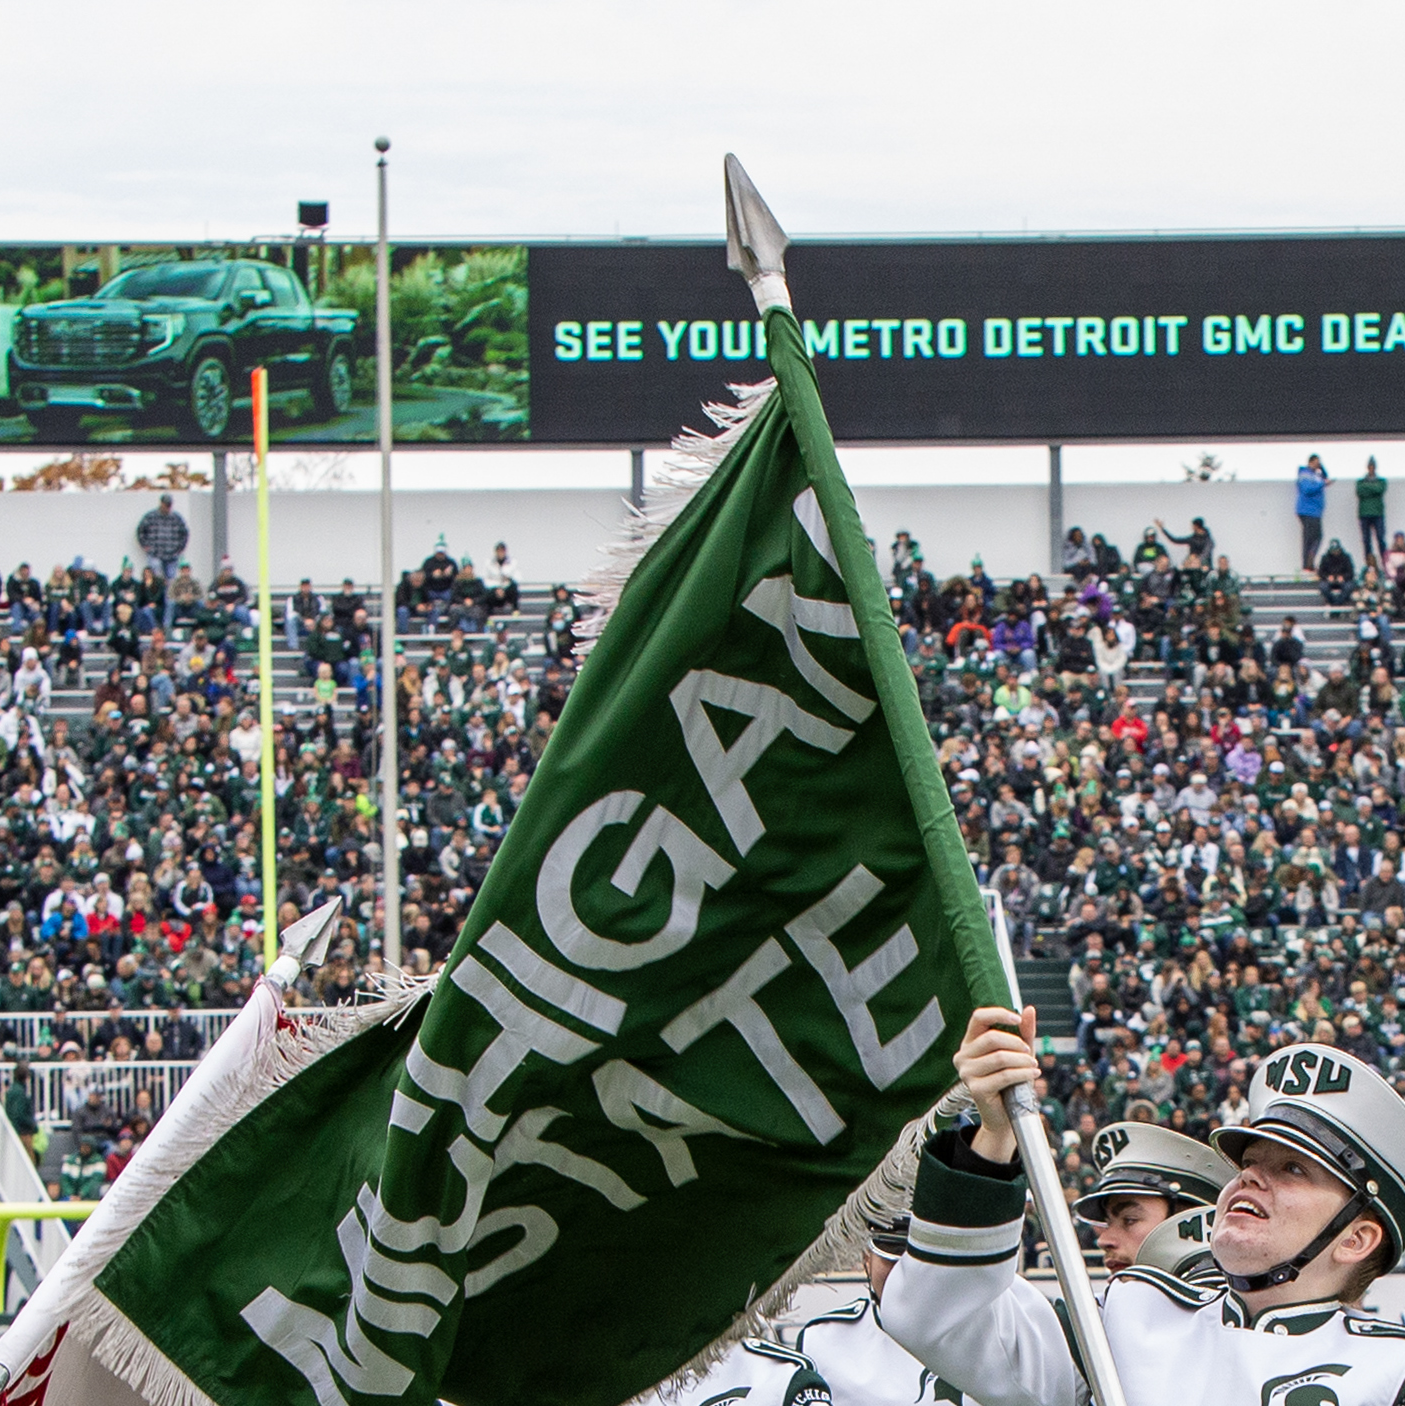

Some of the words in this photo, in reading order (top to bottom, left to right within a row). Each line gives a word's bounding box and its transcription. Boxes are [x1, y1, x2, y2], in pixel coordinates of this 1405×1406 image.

[554, 320, 644, 362] SEE
[802, 318, 968, 360] METRO
[982, 315, 1188, 358] DETROIT
[1201, 313, 1305, 355] GMC
[1265, 1050, 1352, 1096] MSU
